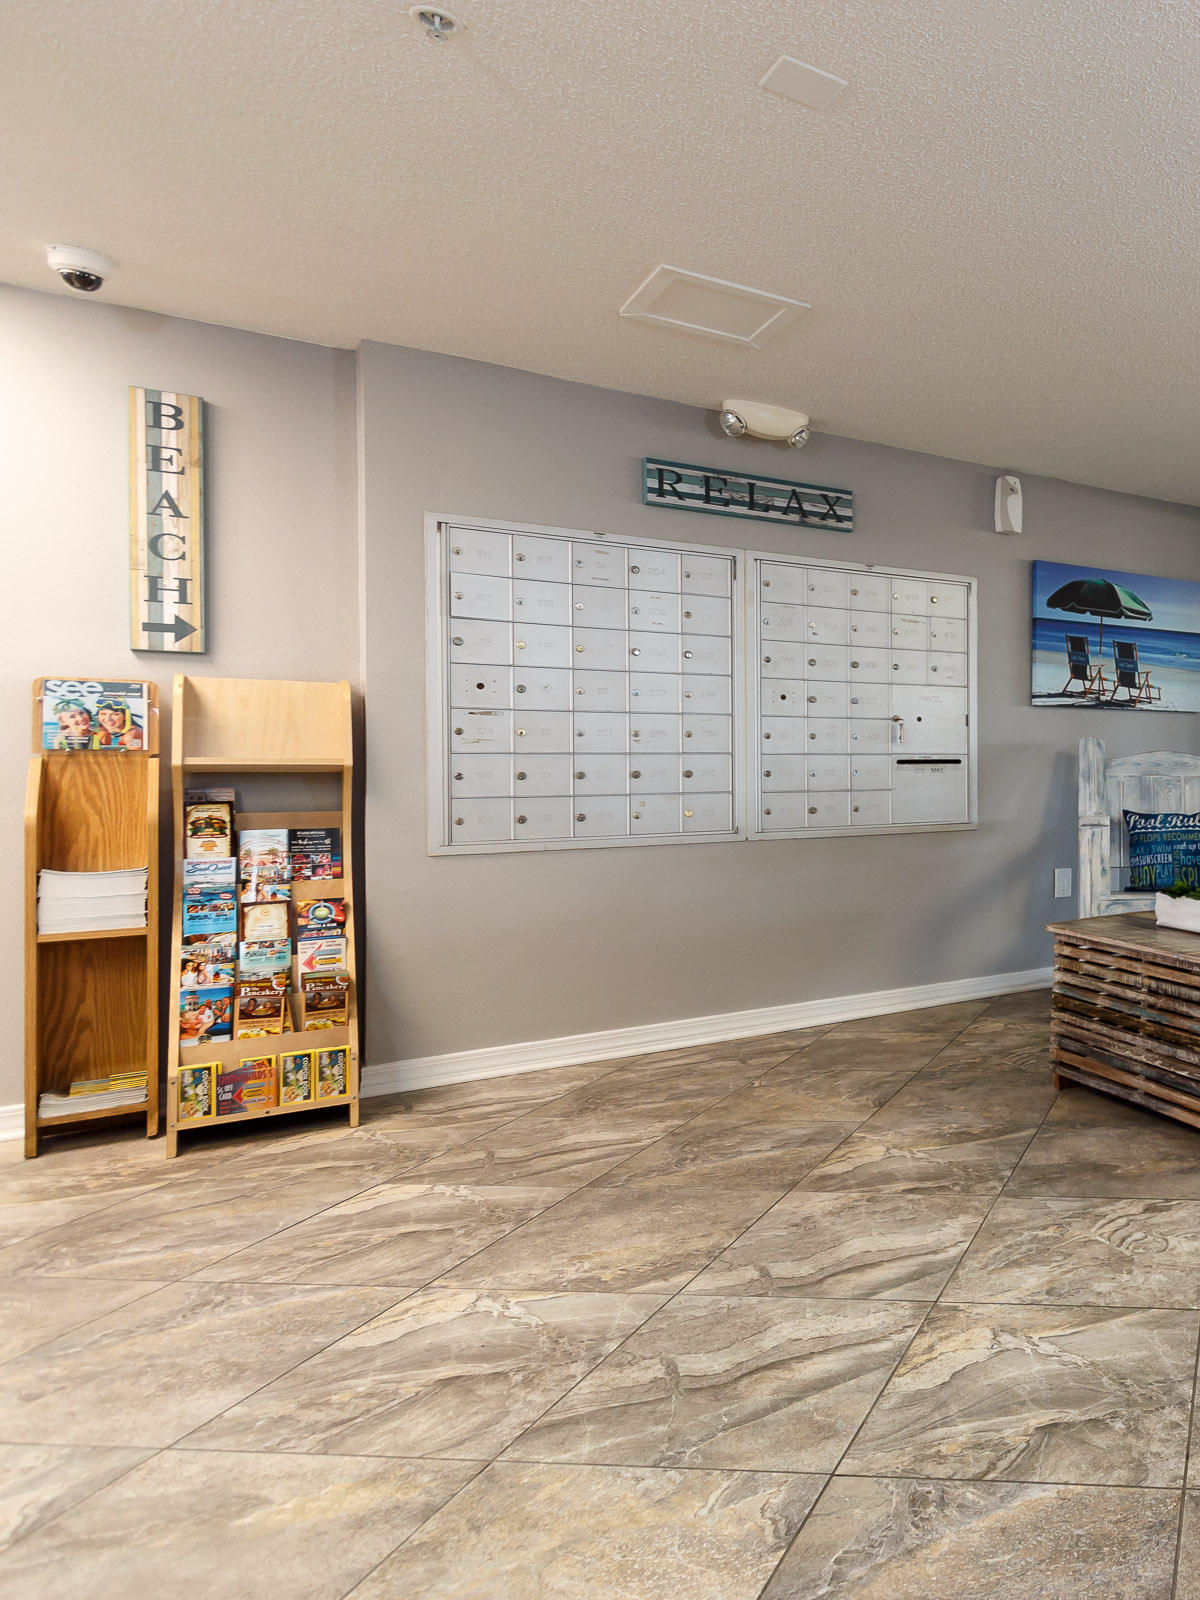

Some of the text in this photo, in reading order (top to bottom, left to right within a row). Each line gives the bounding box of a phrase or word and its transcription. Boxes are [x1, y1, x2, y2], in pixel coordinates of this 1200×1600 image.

[144, 400, 193, 605] BEACH
[655, 467, 845, 523] RELAX
[45, 680, 104, 698] see
[1126, 813, 1163, 829] Pool
[1180, 849, 1200, 866] have
[240, 986, 284, 997] Pancakery
[305, 982, 348, 992] Pancakery
